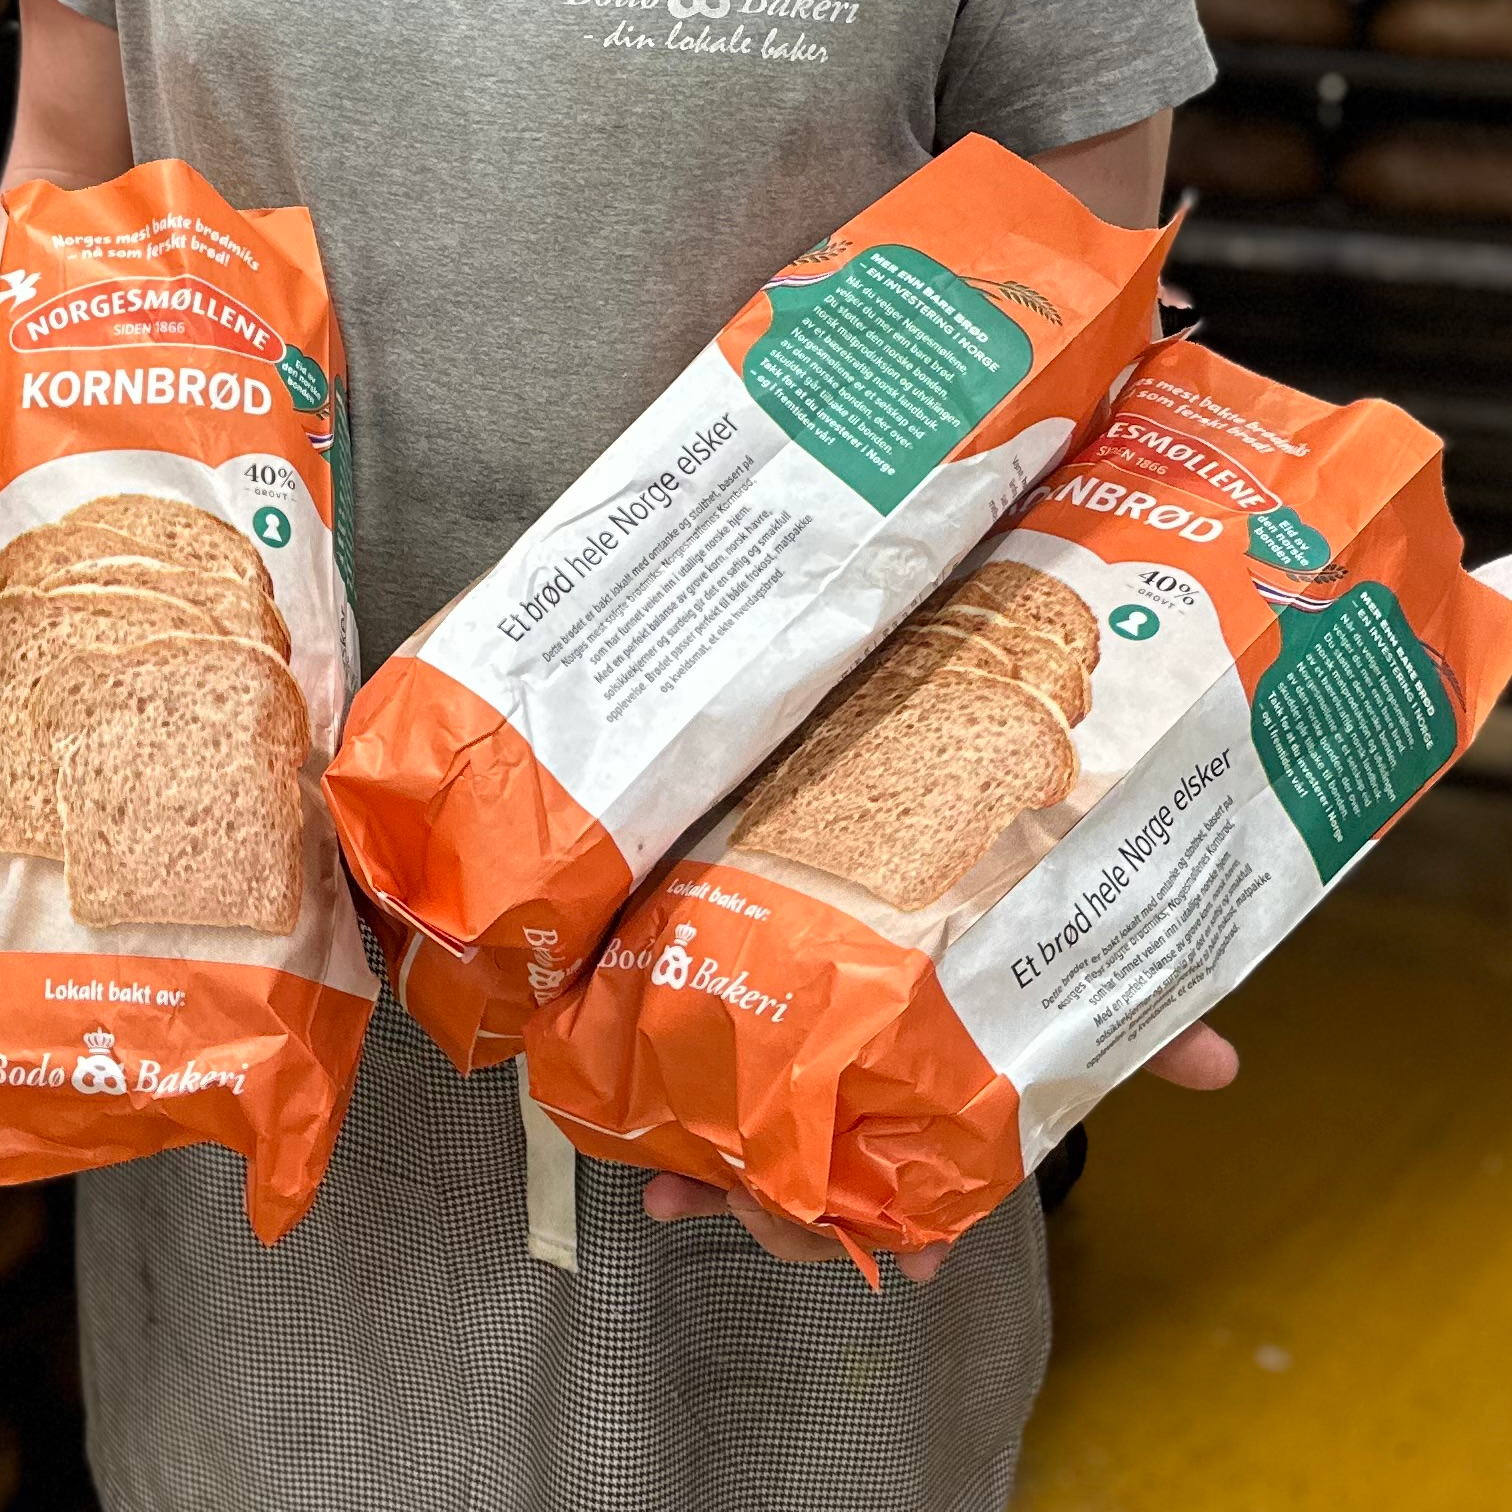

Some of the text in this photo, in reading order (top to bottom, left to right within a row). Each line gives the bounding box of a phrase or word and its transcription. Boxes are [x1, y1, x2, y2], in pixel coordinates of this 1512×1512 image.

[603, 19, 829, 63] din lokale baker
[52, 212, 261, 272] Norges mest bakte brødmiks
[81, 233, 231, 268] nå som ferskt brød!
[26, 286, 272, 352] NORGESMØLLENE
[865, 265, 884, 283] EN
[882, 276, 955, 335] INVESTERING
[956, 336, 1000, 373] NORGE
[869, 250, 990, 344] MER ENN BARE BRØD
[113, 320, 186, 337] SIDEN 1866
[21, 366, 273, 417] KORNBRØD
[281, 361, 298, 378] den
[287, 378, 316, 405] bonden
[1136, 390, 1275, 454] som ferskt brød!
[1156, 380, 1200, 403] mest
[1200, 395, 1246, 425] bakte
[244, 463, 296, 491] 40%
[1135, 457, 1169, 476] 1866
[496, 411, 740, 643] Et brød hele Norge elsker
[559, 617, 587, 644] brødet
[592, 592, 613, 613] bakt
[608, 572, 634, 597] lokalt
[629, 556, 650, 577] med
[646, 526, 680, 561] omtanke
[677, 517, 693, 533] og
[716, 465, 744, 492] basert
[739, 454, 756, 472] på
[1254, 527, 1292, 565] bonden
[1257, 514, 1310, 567] den norske
[1279, 520, 1310, 551] Eid av
[1138, 570, 1199, 607] 40%
[1138, 587, 1177, 610] GROVT
[1359, 589, 1437, 717] MER ENN BARE BRØD
[1356, 608, 1372, 627] EN
[1367, 626, 1416, 704] INVESTERING
[1407, 708, 1438, 750] NORGE
[1010, 747, 1233, 989] Et brød hele Norge elsker
[667, 878, 772, 922] Lokalt bakt av:
[45, 978, 186, 1008] Lokalt bakt av:
[689, 957, 793, 1024] Bakeri
[132, 1059, 250, 1096] Bakeri
